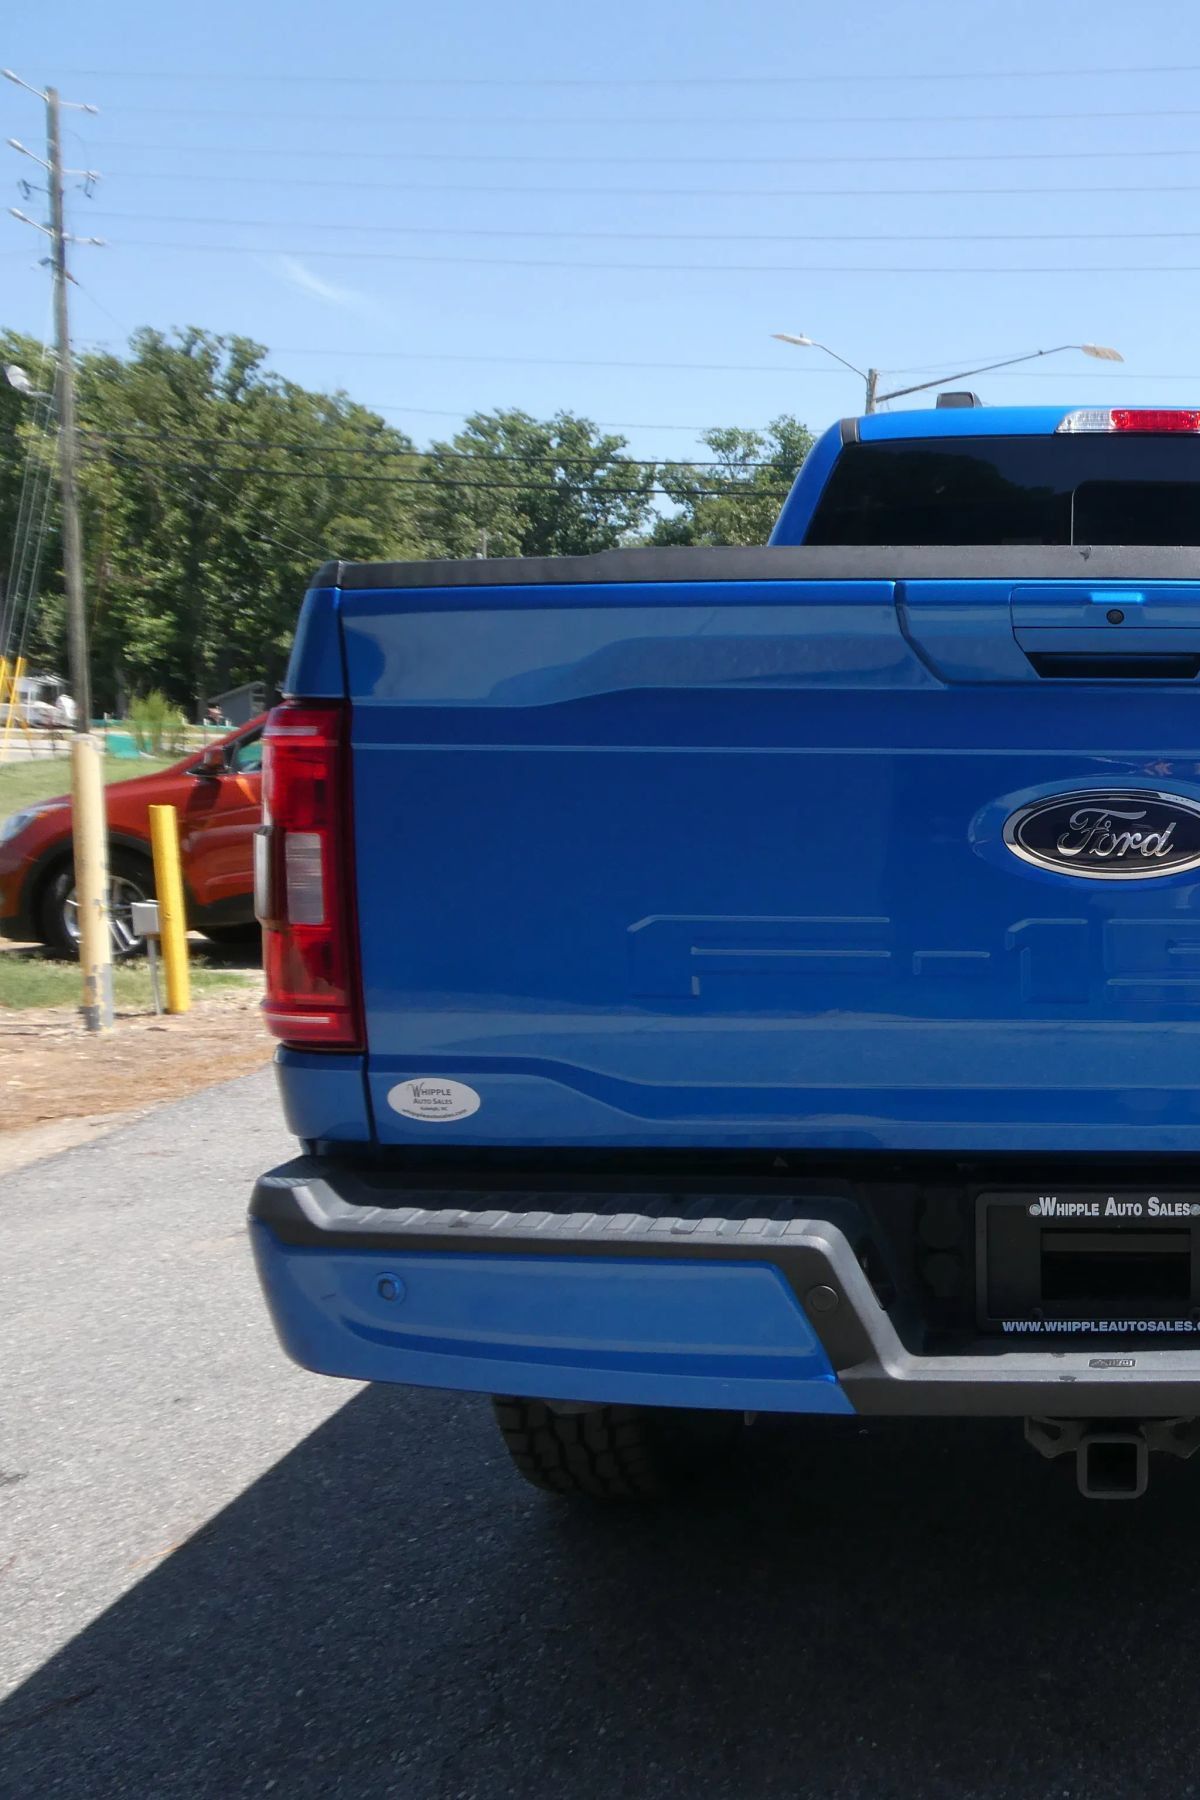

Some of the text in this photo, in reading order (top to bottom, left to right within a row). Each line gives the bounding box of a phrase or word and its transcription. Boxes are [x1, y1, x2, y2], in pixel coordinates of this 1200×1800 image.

[1056, 807, 1177, 857] Ford
[407, 1082, 452, 1097] WHIPPLE
[1039, 1196, 1191, 1217] WHIPPLE AUTO SALES
